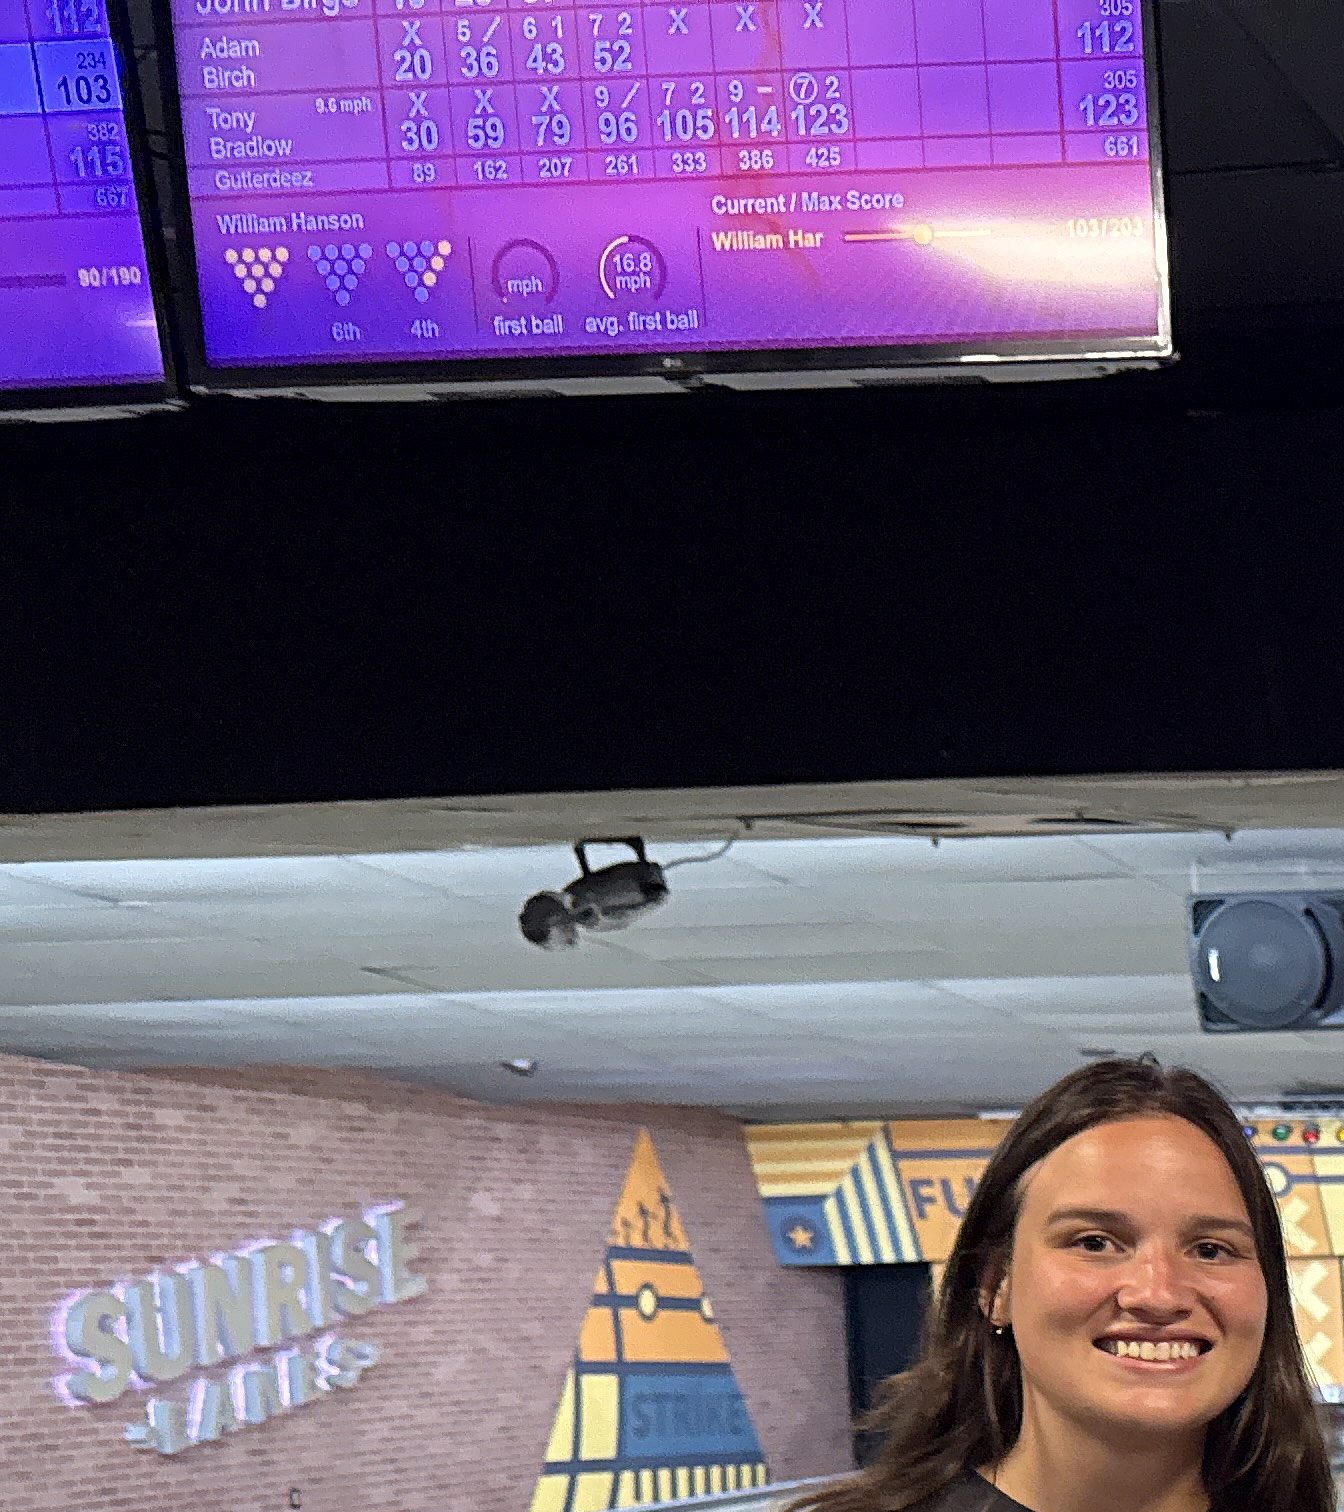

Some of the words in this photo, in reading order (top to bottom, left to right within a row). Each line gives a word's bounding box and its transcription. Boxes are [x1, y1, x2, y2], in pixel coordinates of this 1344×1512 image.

[402, 19, 422, 46] X
[456, 18, 471, 42] 5
[522, 15, 537, 40] 6
[552, 15, 563, 38] 1
[589, 12, 603, 37] 7
[617, 11, 633, 35] 2
[668, 8, 689, 35] X
[735, 4, 756, 32] X
[803, 1, 824, 29] X
[200, 36, 260, 59] Adam
[393, 48, 433, 82] 20
[460, 45, 499, 78] 36
[526, 42, 565, 75] 43
[593, 39, 633, 73] 52
[1077, 20, 1134, 54] 112
[202, 65, 257, 88] Birch
[57, 74, 111, 105] 103
[408, 90, 429, 118] X
[473, 88, 496, 115] X
[539, 85, 562, 113] X
[594, 85, 609, 109] 9
[661, 82, 675, 105] 7
[690, 81, 705, 105] 2
[728, 79, 743, 103] 9
[825, 75, 841, 100] 2
[1103, 70, 1137, 89] 305
[205, 107, 255, 133] Tony
[401, 119, 439, 151] 30
[467, 116, 505, 149] 59
[531, 113, 571, 147] 79
[598, 111, 638, 145] 96
[657, 108, 716, 142] 105
[725, 106, 782, 139] 114
[791, 103, 849, 136] 123
[1079, 93, 1139, 126] 123
[209, 136, 293, 159] Bradlow
[69, 145, 123, 177] 115
[215, 169, 313, 190] Gutterdeez
[412, 162, 436, 183] 89
[473, 159, 508, 182] 162
[538, 156, 573, 179] 207
[605, 153, 639, 176] 261
[671, 151, 707, 173] 333
[739, 149, 774, 171] 386
[805, 146, 841, 168] 425
[1104, 135, 1138, 157] 661
[711, 195, 787, 216] Current
[801, 193, 841, 213] Max
[846, 190, 904, 211] Score
[216, 213, 287, 235] William
[289, 211, 365, 232] Hanson
[711, 231, 784, 252] William
[613, 253, 652, 273] 16.8
[507, 276, 543, 296] mph
[615, 273, 651, 293] mph
[493, 316, 527, 336] first
[531, 314, 564, 334] ball
[628, 312, 662, 332] first
[666, 310, 699, 329] ball
[52, 1200, 430, 1407] SUNRISE
